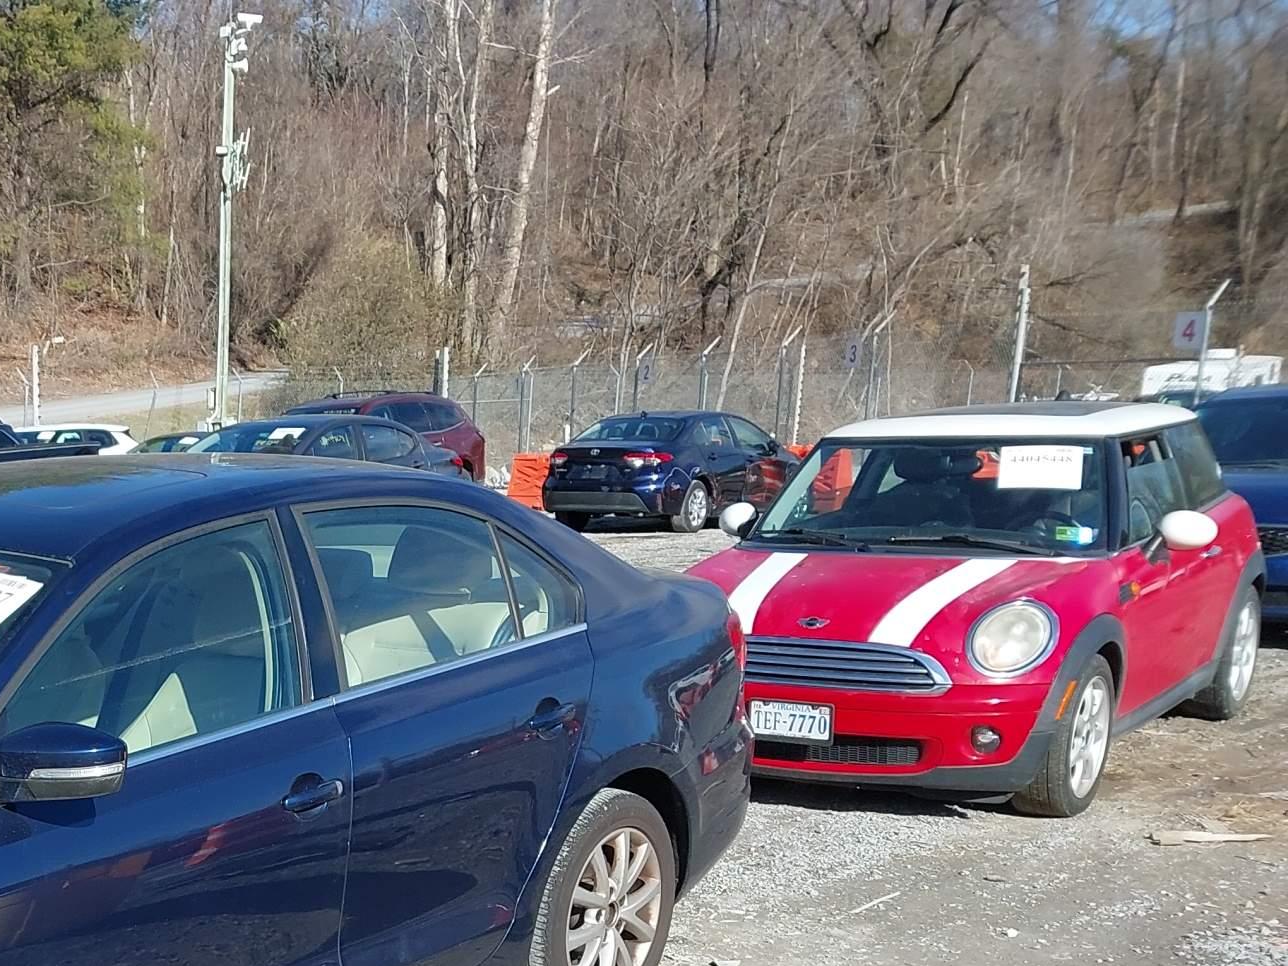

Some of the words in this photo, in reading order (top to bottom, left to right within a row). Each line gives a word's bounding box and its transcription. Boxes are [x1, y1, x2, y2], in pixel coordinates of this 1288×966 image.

[1181, 319, 1196, 342] 4
[848, 344, 858, 362] 3
[642, 365, 651, 380] 2
[772, 702, 811, 713] VIRGINIA
[754, 710, 828, 735] TEF-7770
